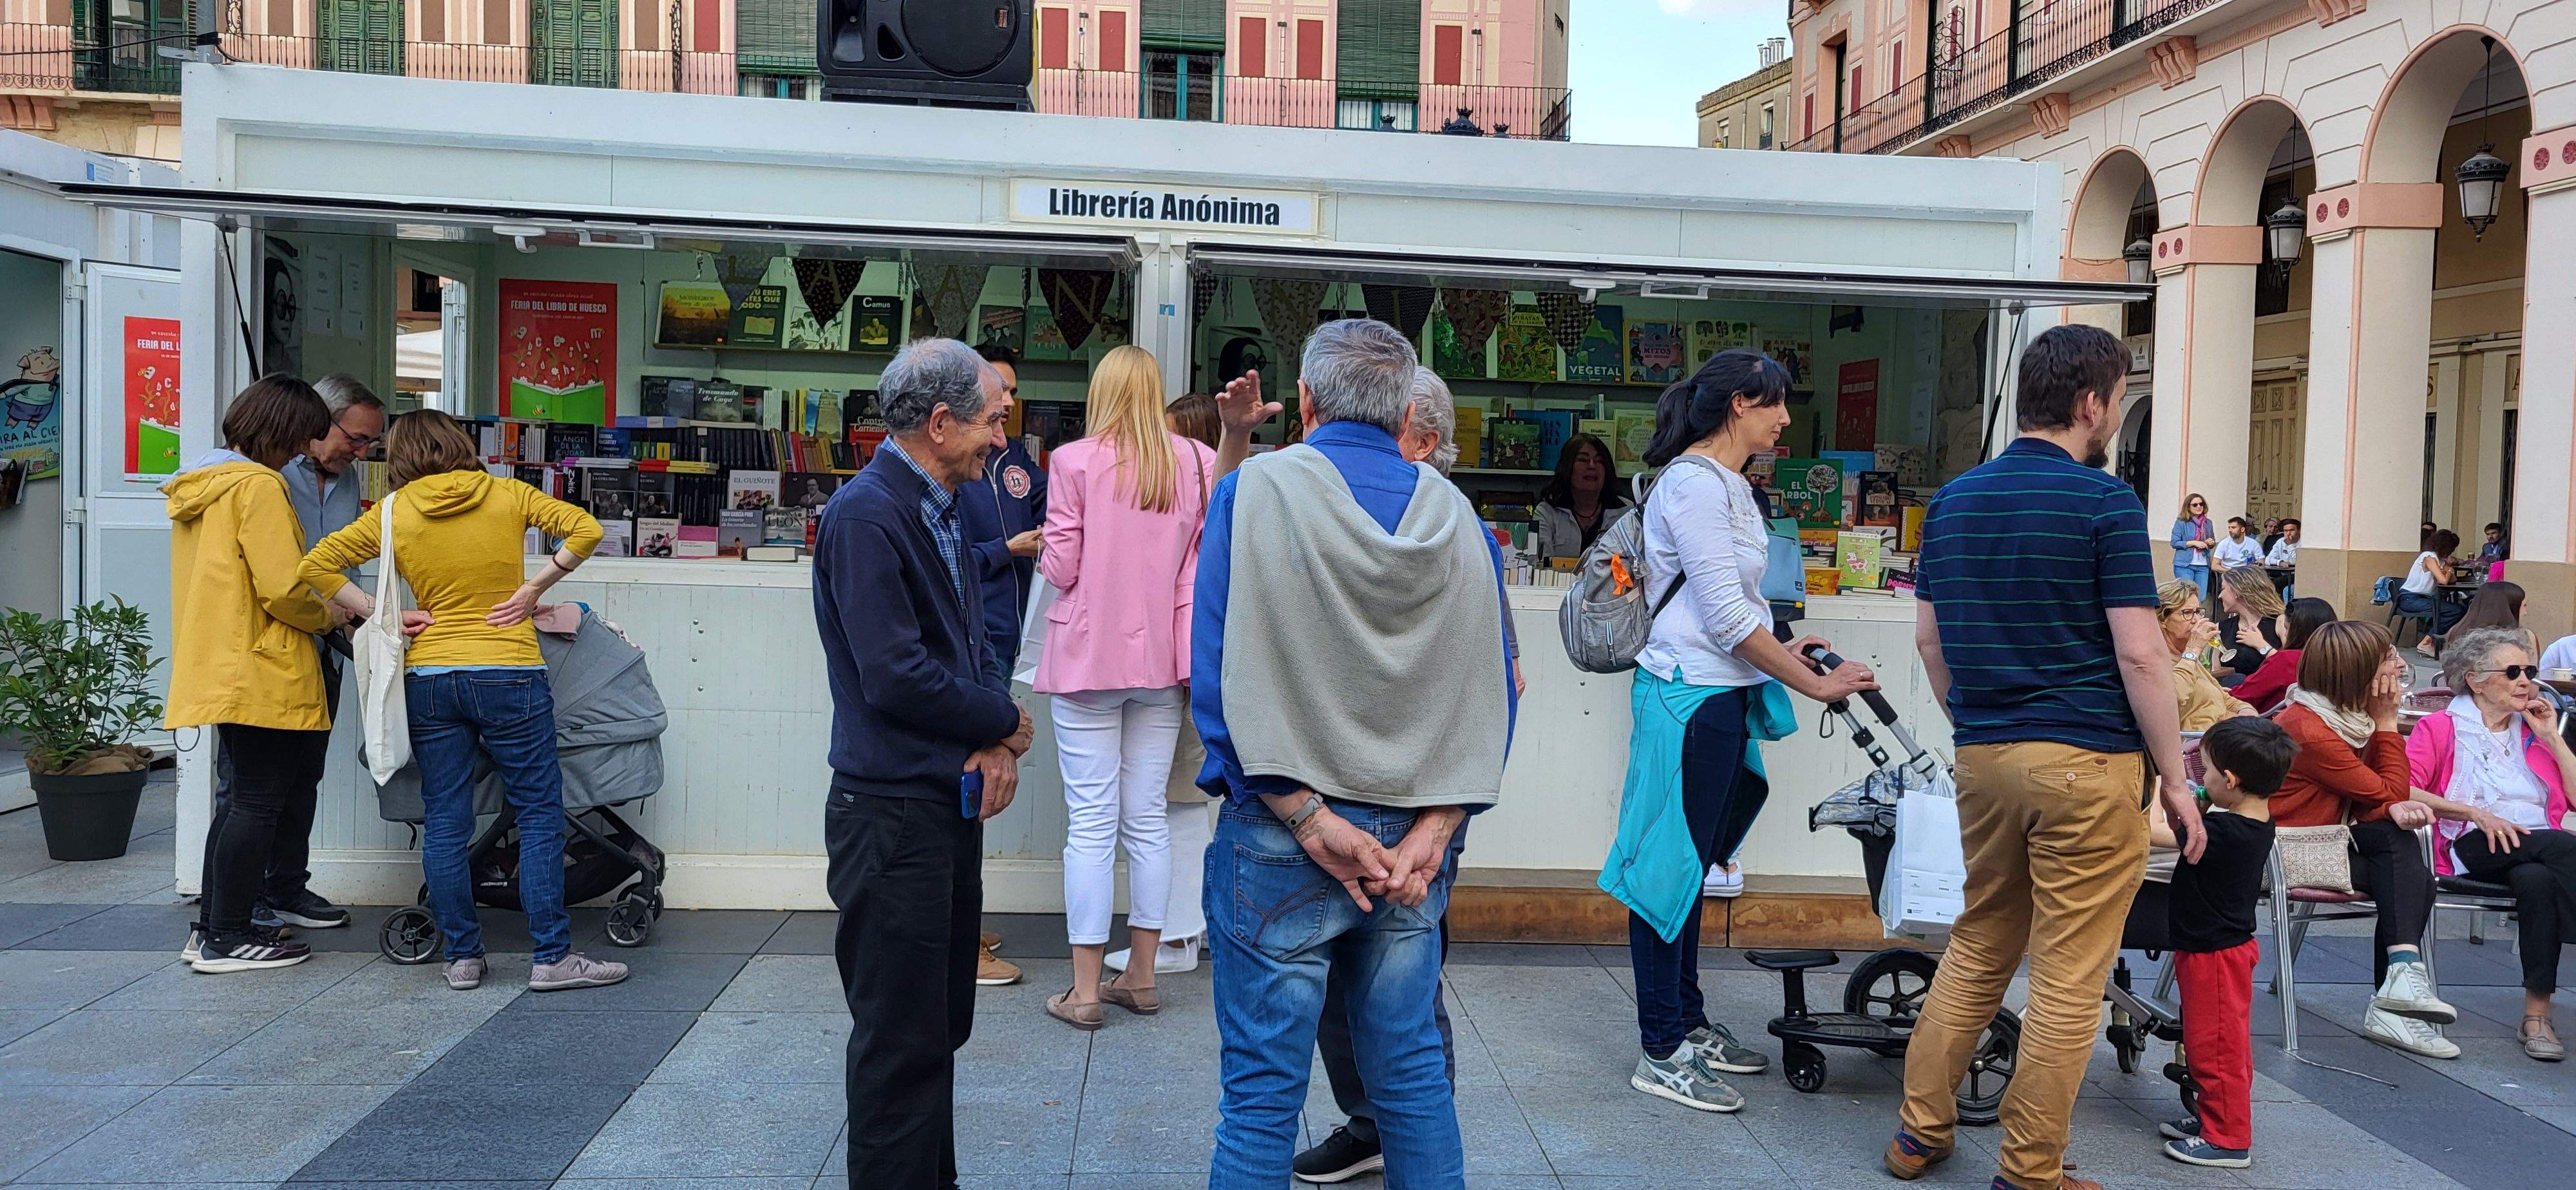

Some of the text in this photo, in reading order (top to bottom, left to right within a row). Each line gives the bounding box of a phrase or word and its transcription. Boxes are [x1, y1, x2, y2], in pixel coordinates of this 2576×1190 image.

[1049, 188, 1280, 226] Librería Anónima
[511, 300, 607, 313] FERIA DEL LIBRO DE HUESCA
[862, 297, 891, 308] Camus
[137, 339, 159, 350] FERIA
[160, 340, 175, 351] DEL
[1569, 365, 1622, 376] VEGETAL
[714, 396, 733, 406] Goya
[23, 430, 37, 440] AL
[41, 425, 60, 439] CIE
[767, 516, 803, 527] LEON
